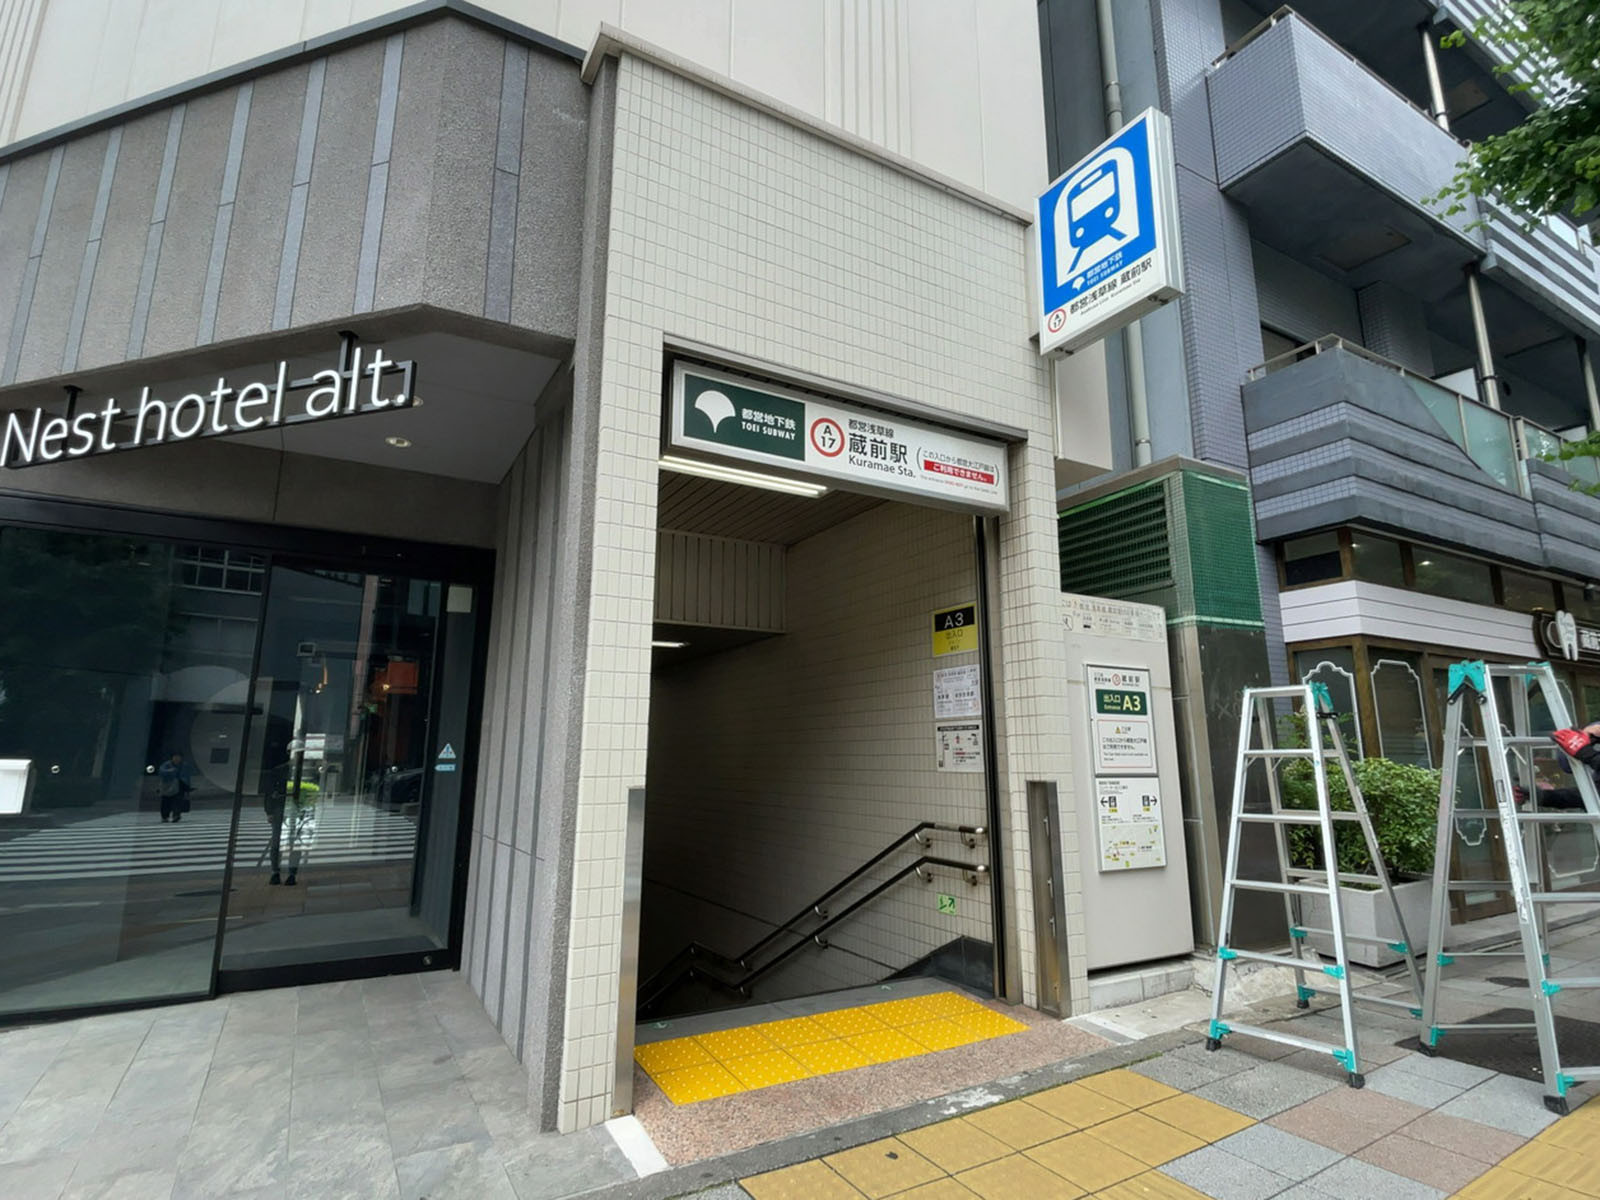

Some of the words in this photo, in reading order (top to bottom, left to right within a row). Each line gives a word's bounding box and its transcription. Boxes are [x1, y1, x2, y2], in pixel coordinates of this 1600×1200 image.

[1070, 278, 1118, 314] 都営浅草線
[1120, 257, 1152, 285] 蔵前駅
[0, 399, 120, 466] Nest
[134, 361, 288, 445] hotel
[305, 347, 408, 418] alt.
[742, 408, 796, 430] 都営地下鉄
[848, 418, 895, 438] 都営浅草線
[741, 421, 760, 433] TOEI
[762, 426, 796, 440] SUBWAY
[823, 424, 833, 436] A
[821, 436, 836, 449] 17
[848, 432, 908, 465] 蔵前駅
[848, 454, 896, 474] Kuramae
[897, 465, 917, 479] Sta.
[944, 612, 964, 629] A3
[1122, 694, 1142, 711] A3
